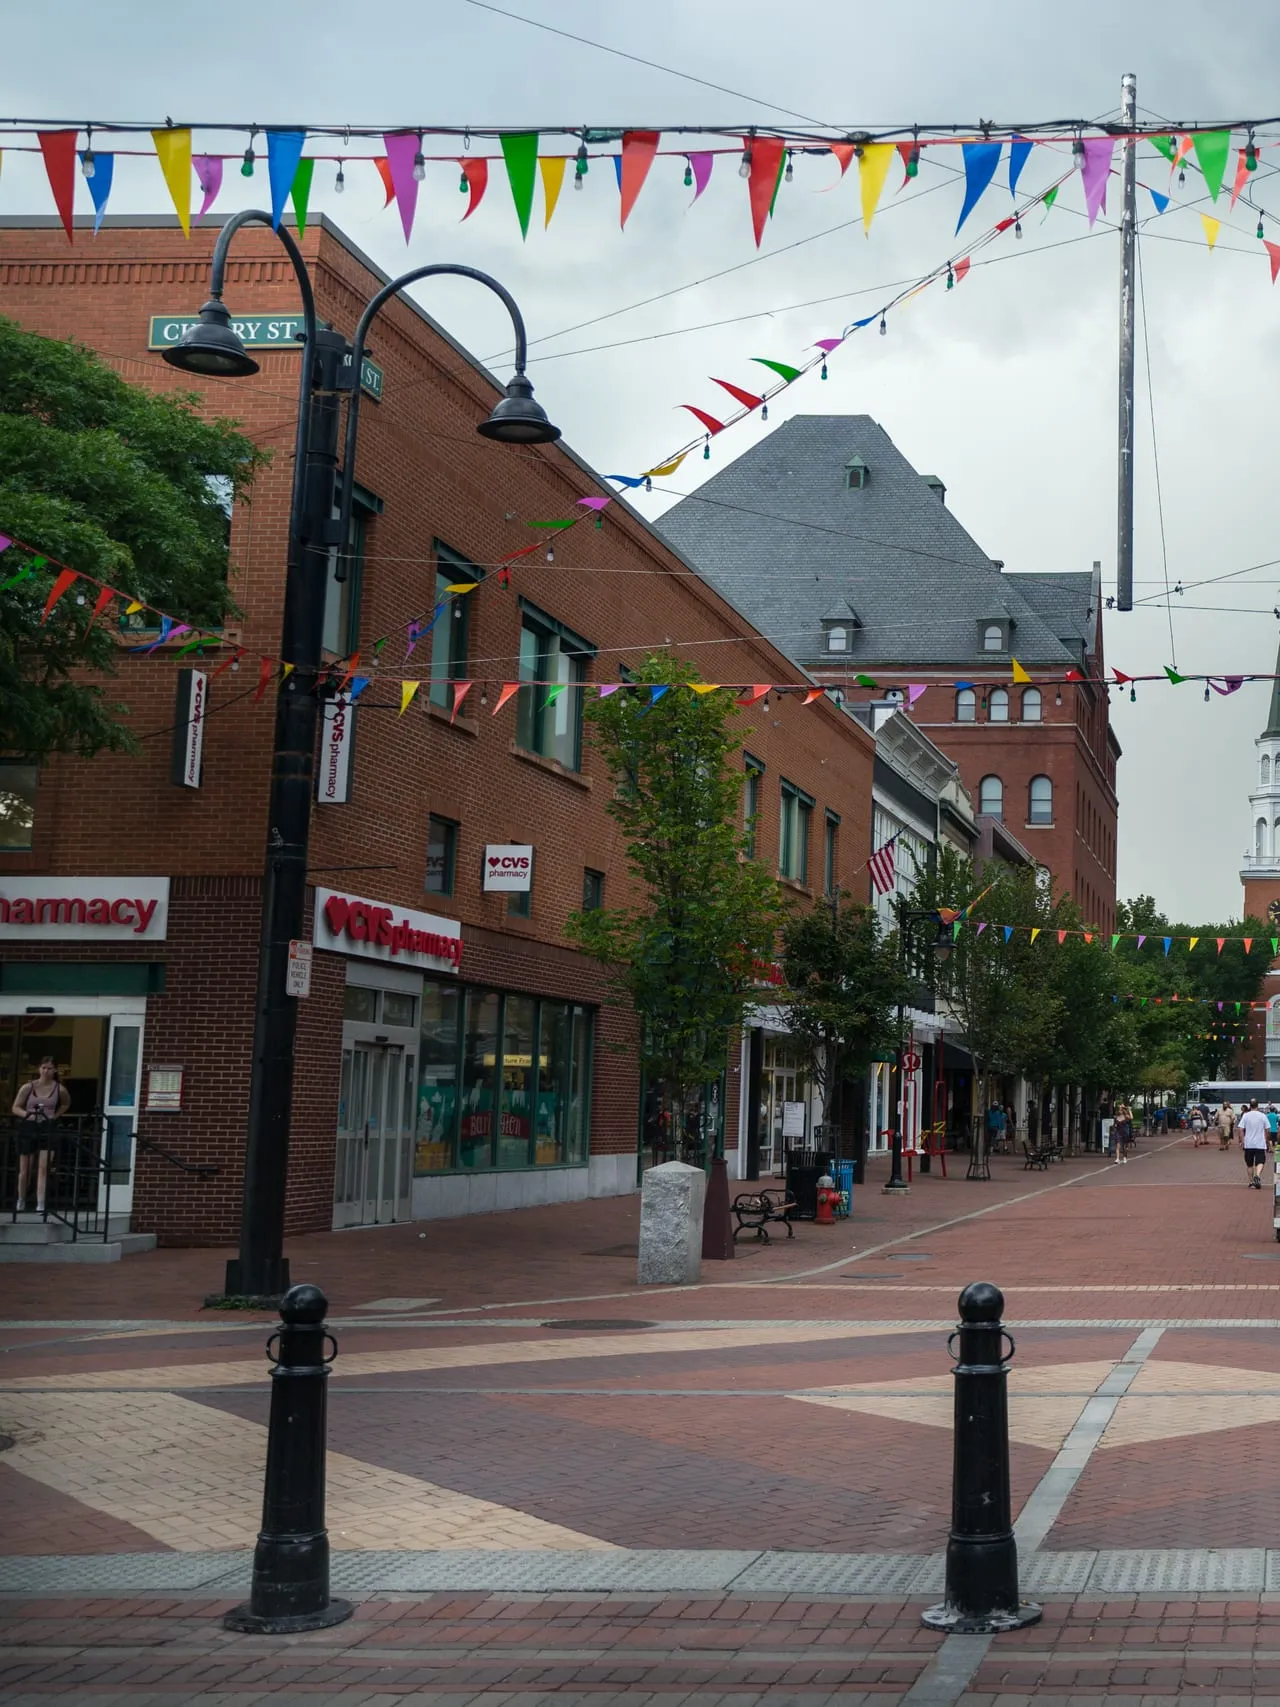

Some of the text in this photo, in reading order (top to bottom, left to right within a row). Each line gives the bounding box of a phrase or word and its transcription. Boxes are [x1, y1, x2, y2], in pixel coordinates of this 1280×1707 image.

[163, 322, 262, 341] CRY
[187, 692, 203, 783] CVS pharmacy
[325, 712, 345, 799] CVS pharmacy
[488, 869, 529, 880] pharmacy
[501, 856, 530, 869] CVS
[349, 901, 465, 967] CVS pharmacy
